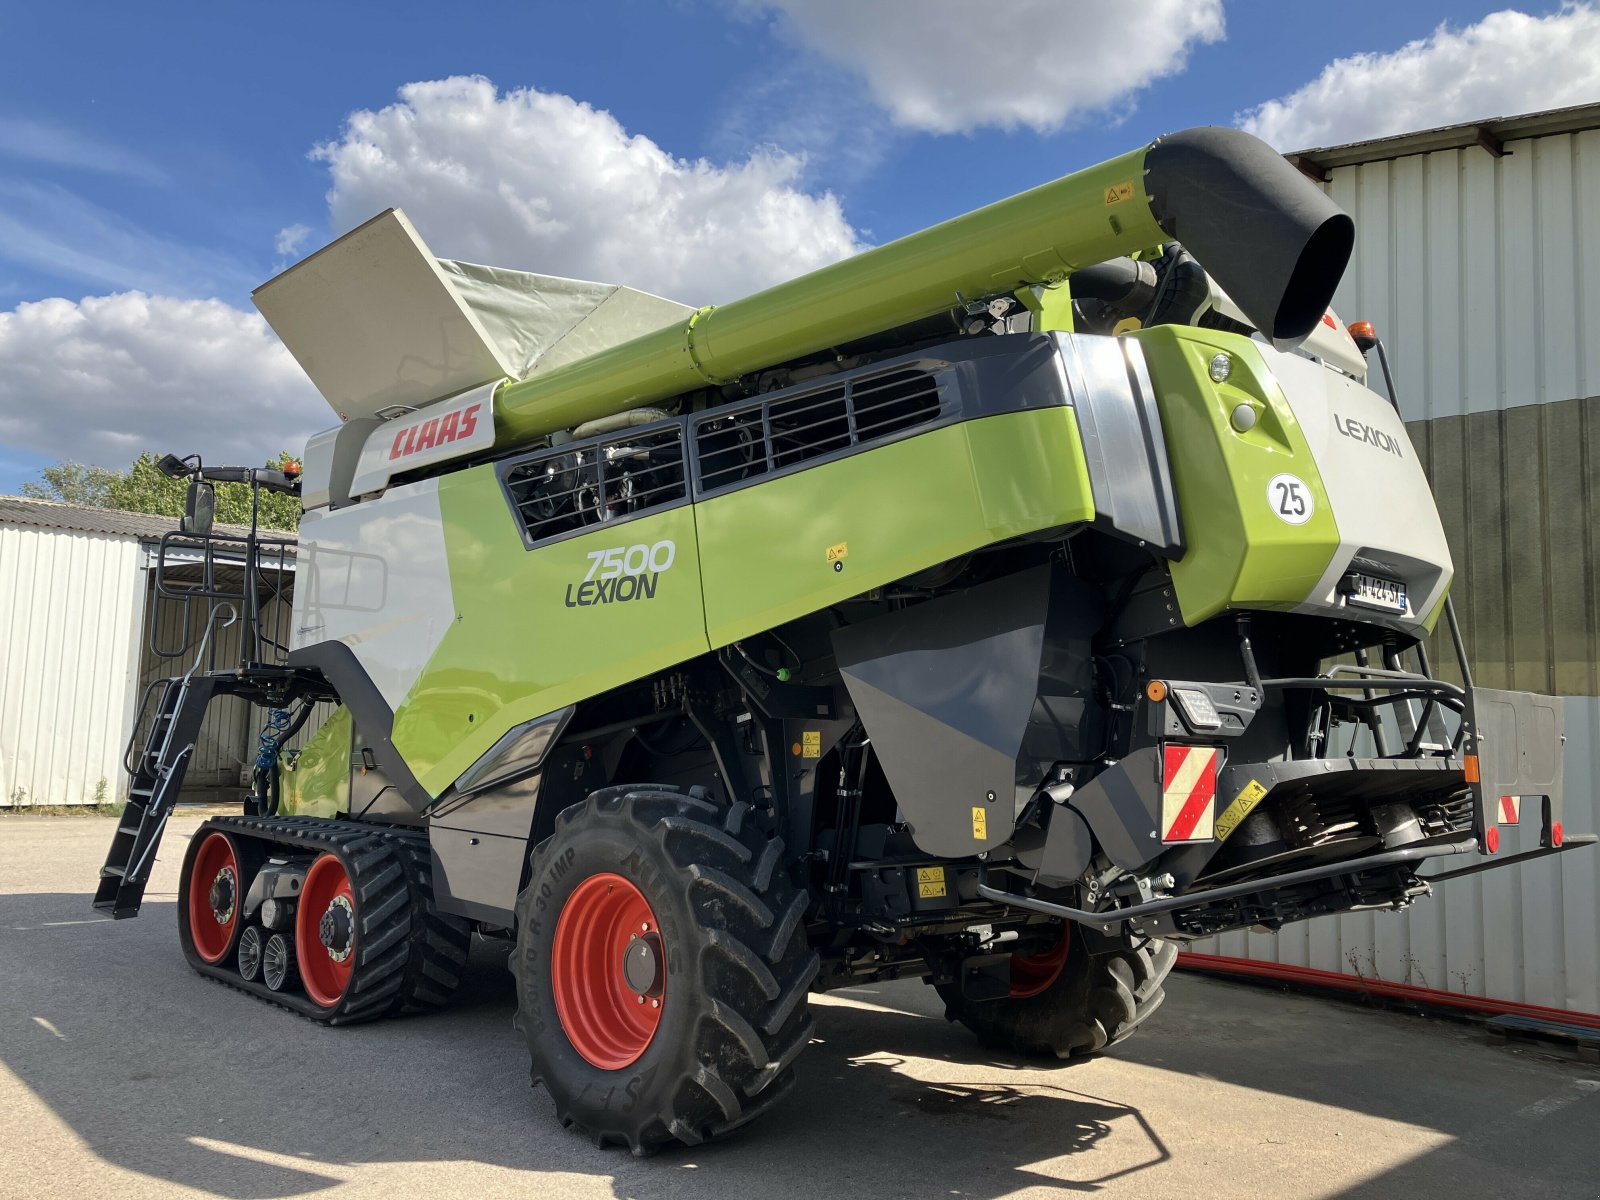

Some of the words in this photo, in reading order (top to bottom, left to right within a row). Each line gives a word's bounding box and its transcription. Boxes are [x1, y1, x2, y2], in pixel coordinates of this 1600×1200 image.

[389, 403, 481, 461] CLAAS
[1333, 413, 1403, 459] LEXION
[1276, 482, 1305, 516] 25
[583, 540, 676, 583] 7500
[565, 571, 659, 608] LEXION
[535, 882, 552, 912] 30
[529, 917, 542, 936] R
